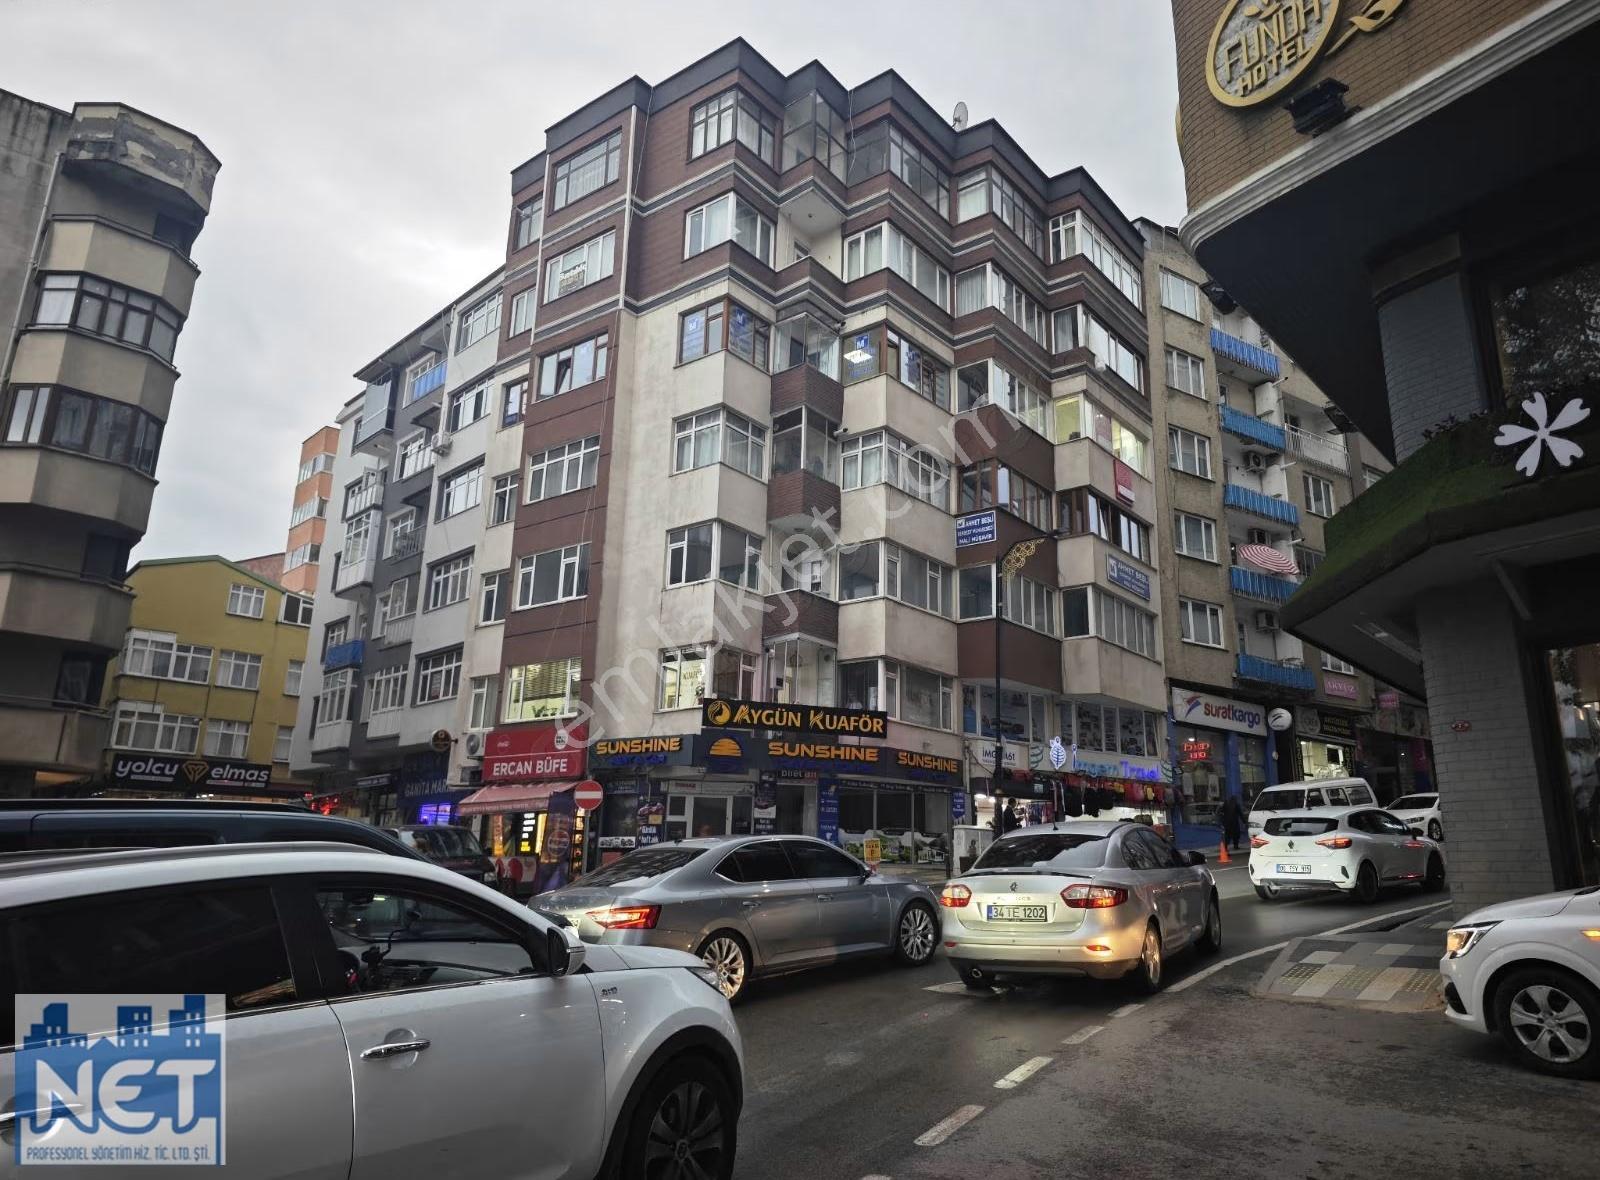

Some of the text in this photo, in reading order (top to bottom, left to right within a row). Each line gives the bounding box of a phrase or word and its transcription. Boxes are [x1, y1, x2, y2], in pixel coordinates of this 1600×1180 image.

[1237, 36, 1314, 97] HOTEL
[733, 704, 884, 733] AYGÜN KUAFÖR
[1203, 702, 1261, 728] suratkargo
[768, 742, 880, 762] SUNSHINE
[897, 752, 959, 773] SUNSHINE
[115, 758, 269, 781] yolcu elmas
[493, 757, 567, 776] ERCAN BÜFE
[993, 907, 1045, 918] 34 TE 1202
